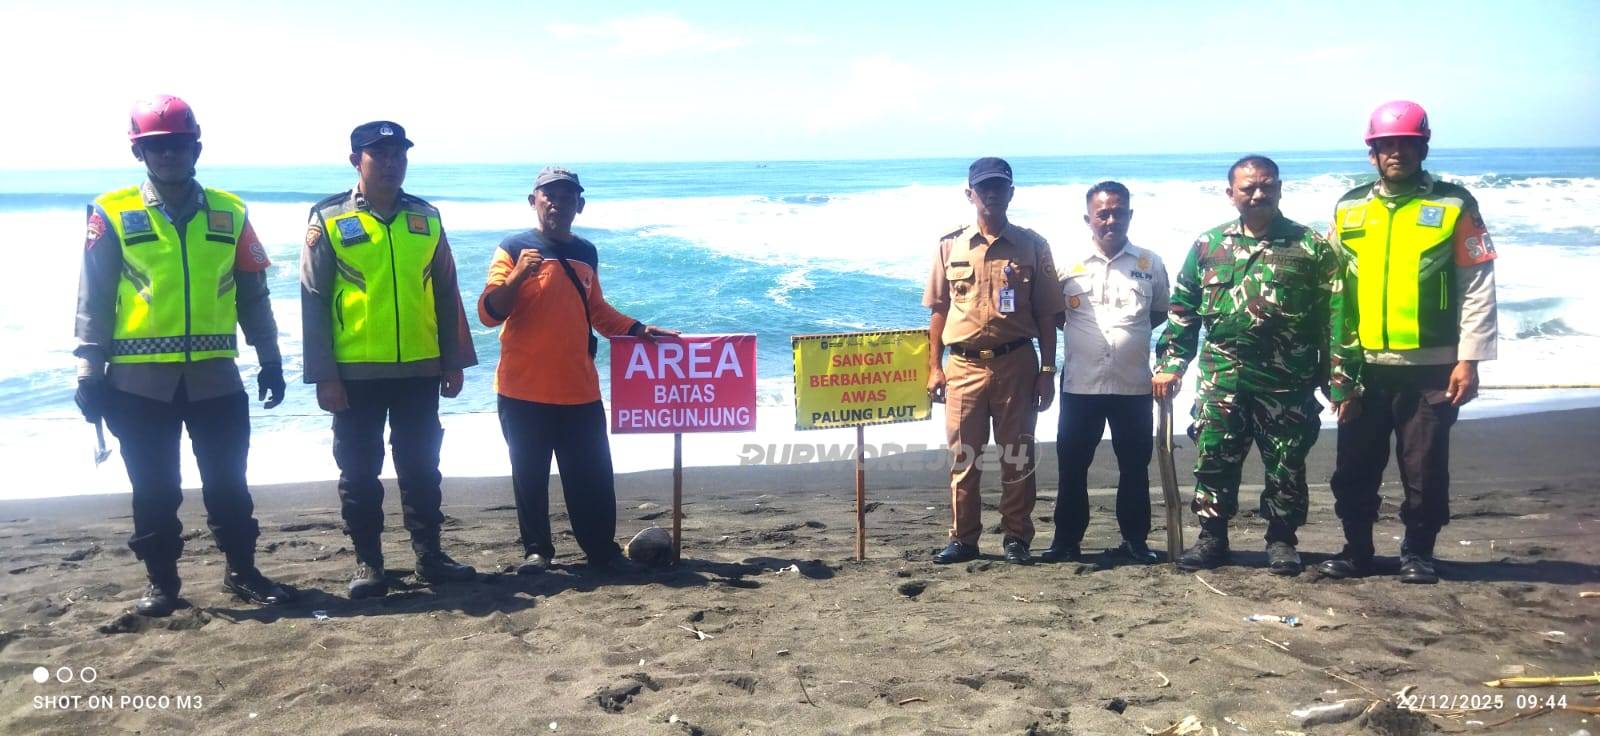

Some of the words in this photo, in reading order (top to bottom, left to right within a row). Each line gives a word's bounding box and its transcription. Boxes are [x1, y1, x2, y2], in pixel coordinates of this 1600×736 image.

[624, 342, 744, 380] AREA
[832, 351, 894, 367] SANGAT
[809, 369, 917, 387] BERBAHAYA!!!
[654, 383, 715, 404] BATAS
[841, 390, 887, 404] AWAS
[618, 406, 750, 428] PENGUNJUNG
[812, 408, 873, 423] PALUNG
[878, 405, 916, 418] LAUT
